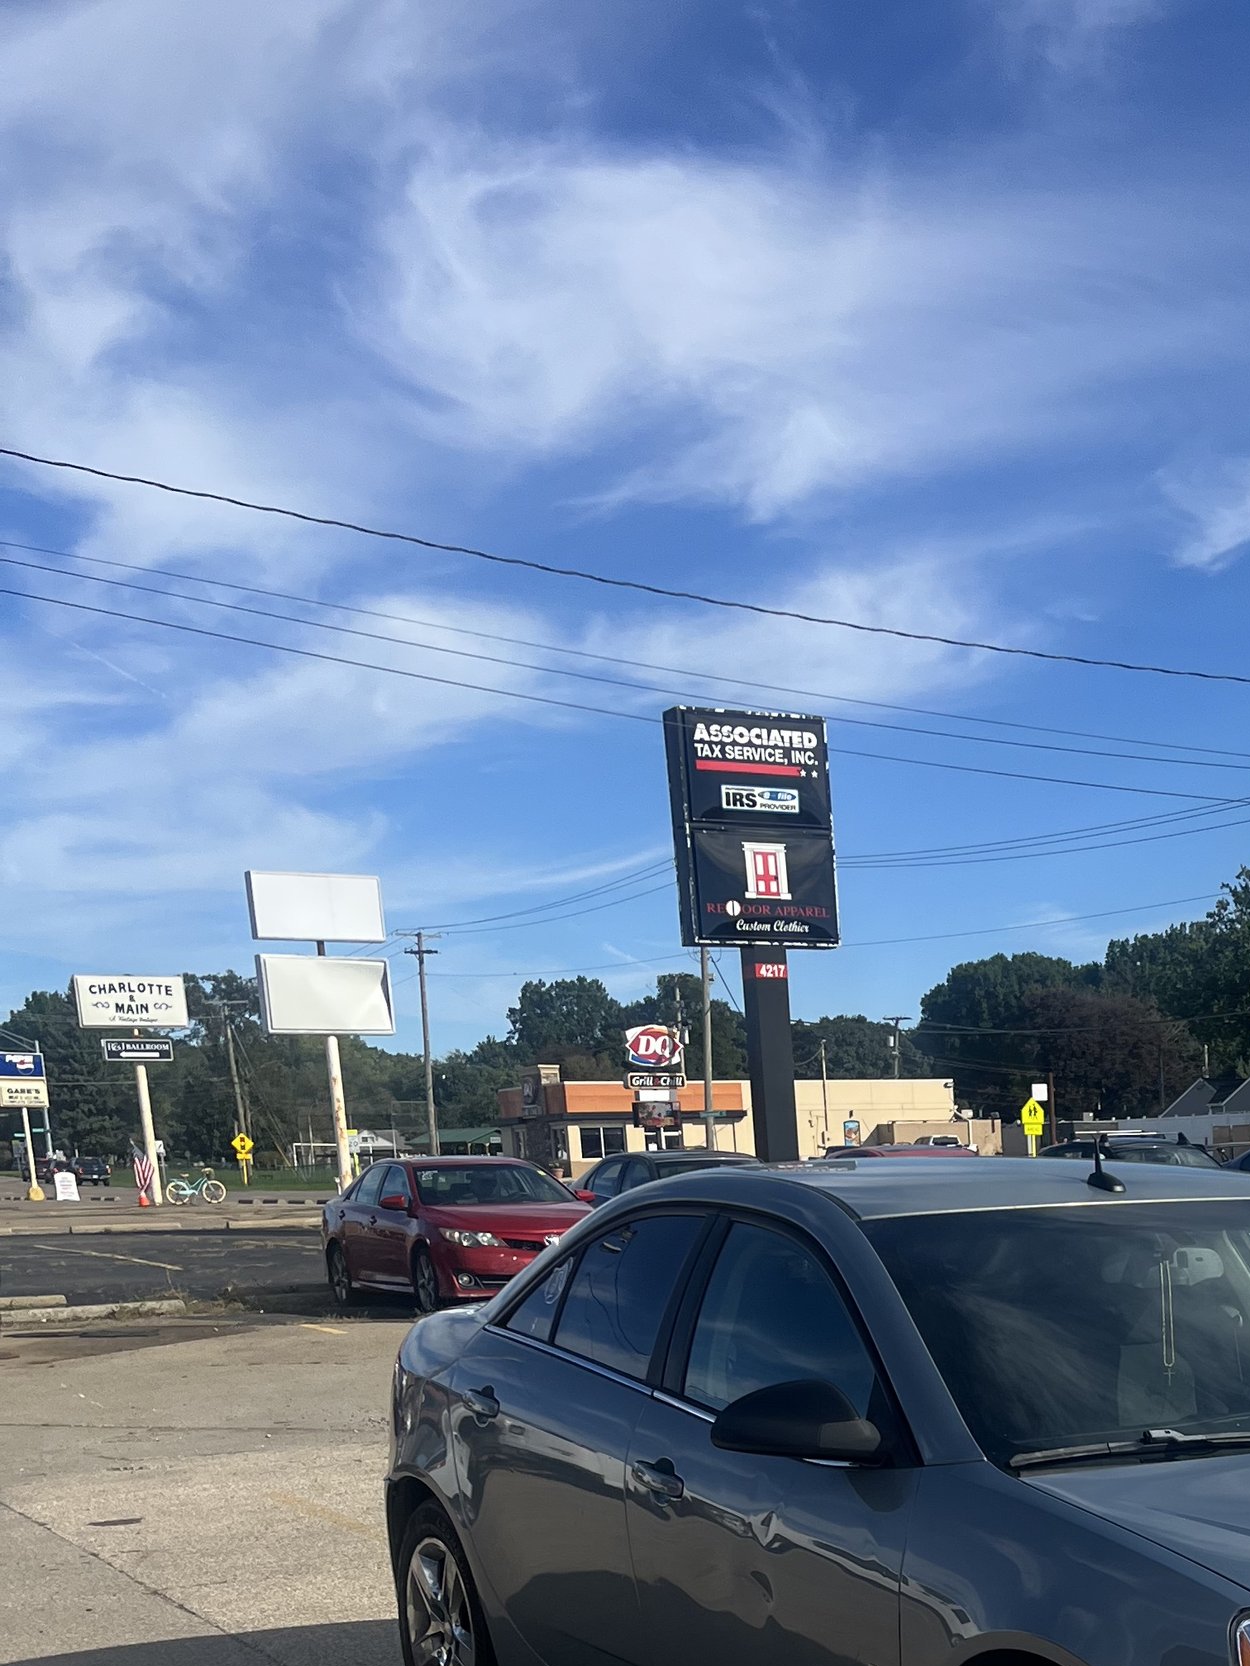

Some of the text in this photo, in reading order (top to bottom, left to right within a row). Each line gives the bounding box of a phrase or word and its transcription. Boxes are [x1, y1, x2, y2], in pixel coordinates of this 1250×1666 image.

[693, 722, 818, 749] ASSOCIATED
[693, 742, 819, 766] TAX SERVICE, INC.
[724, 791, 758, 808] IRS
[759, 802, 797, 811] PROVIDER
[774, 906, 830, 918] APPAREL
[736, 918, 810, 933] Custom Clothier
[760, 964, 785, 978] 4217
[88, 982, 173, 996] CHARLOTTE
[115, 1003, 149, 1015] MAIN
[126, 1043, 170, 1051] BALLROOM
[637, 1035, 673, 1058] DQ
[632, 1076, 653, 1086] Grill
